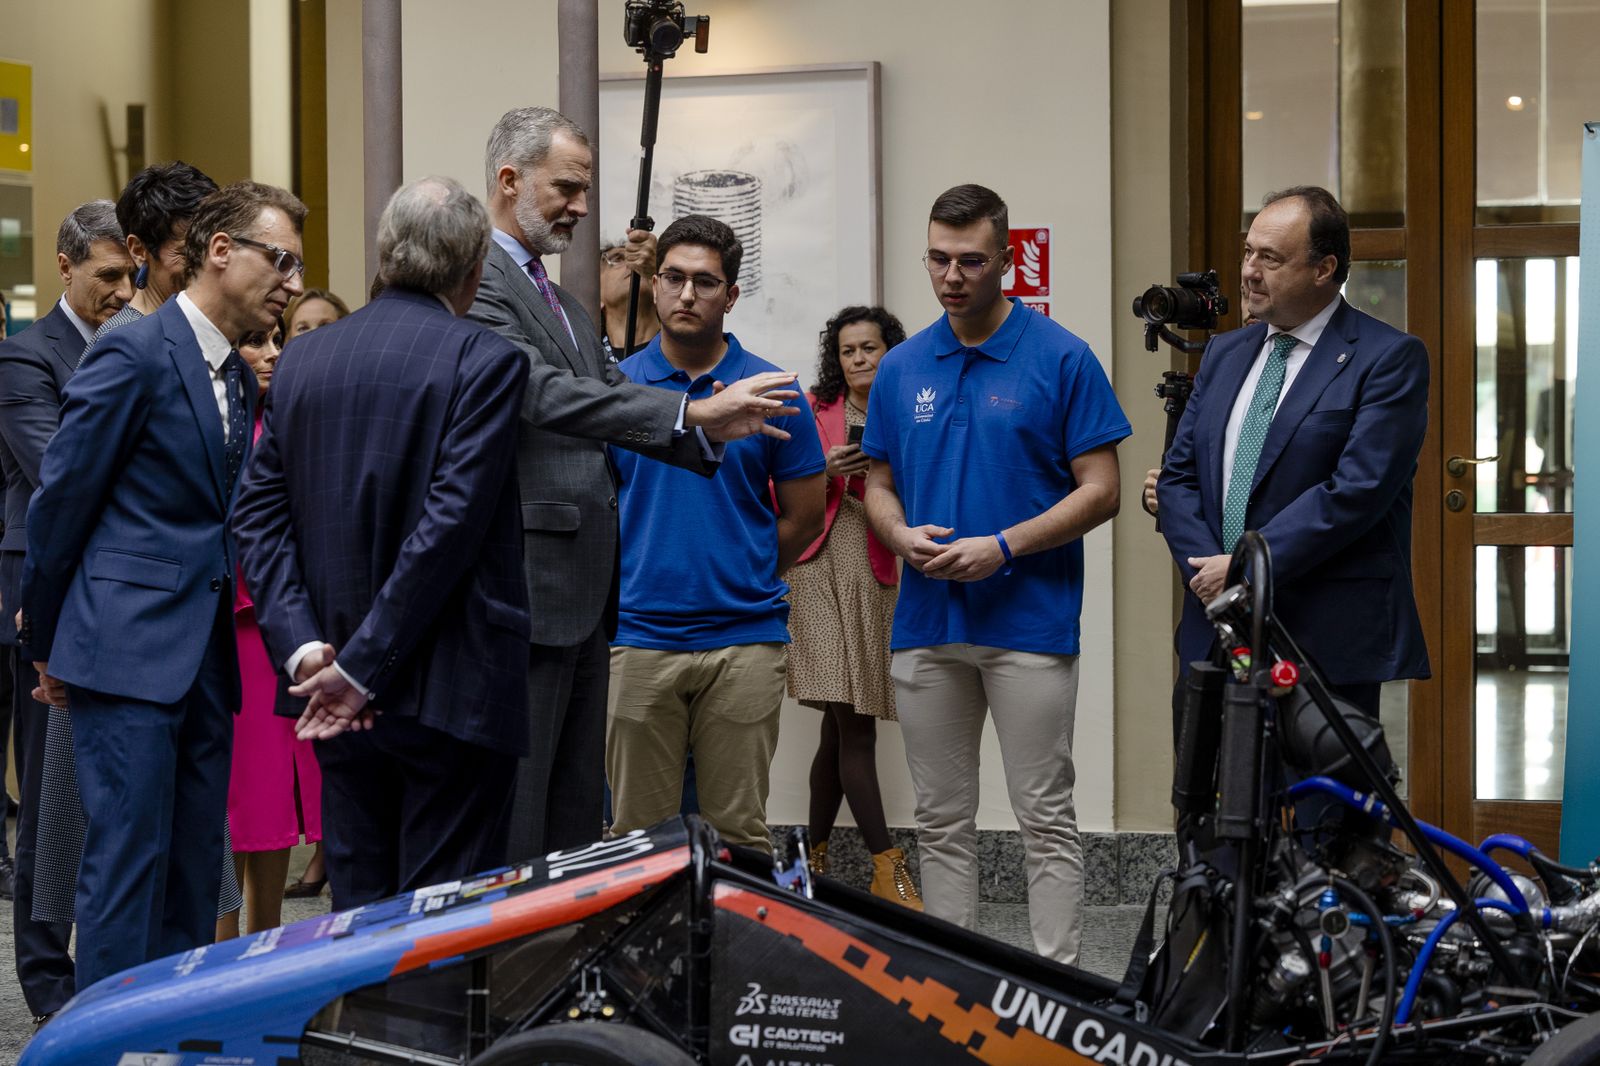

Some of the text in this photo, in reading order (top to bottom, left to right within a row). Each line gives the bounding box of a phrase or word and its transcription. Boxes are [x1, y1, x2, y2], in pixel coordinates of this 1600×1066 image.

[915, 403, 934, 413] UCA
[771, 994, 842, 1009] DASSAULT
[991, 978, 1193, 1066] UNI CAD
[763, 1026, 845, 1044] CADTECH
